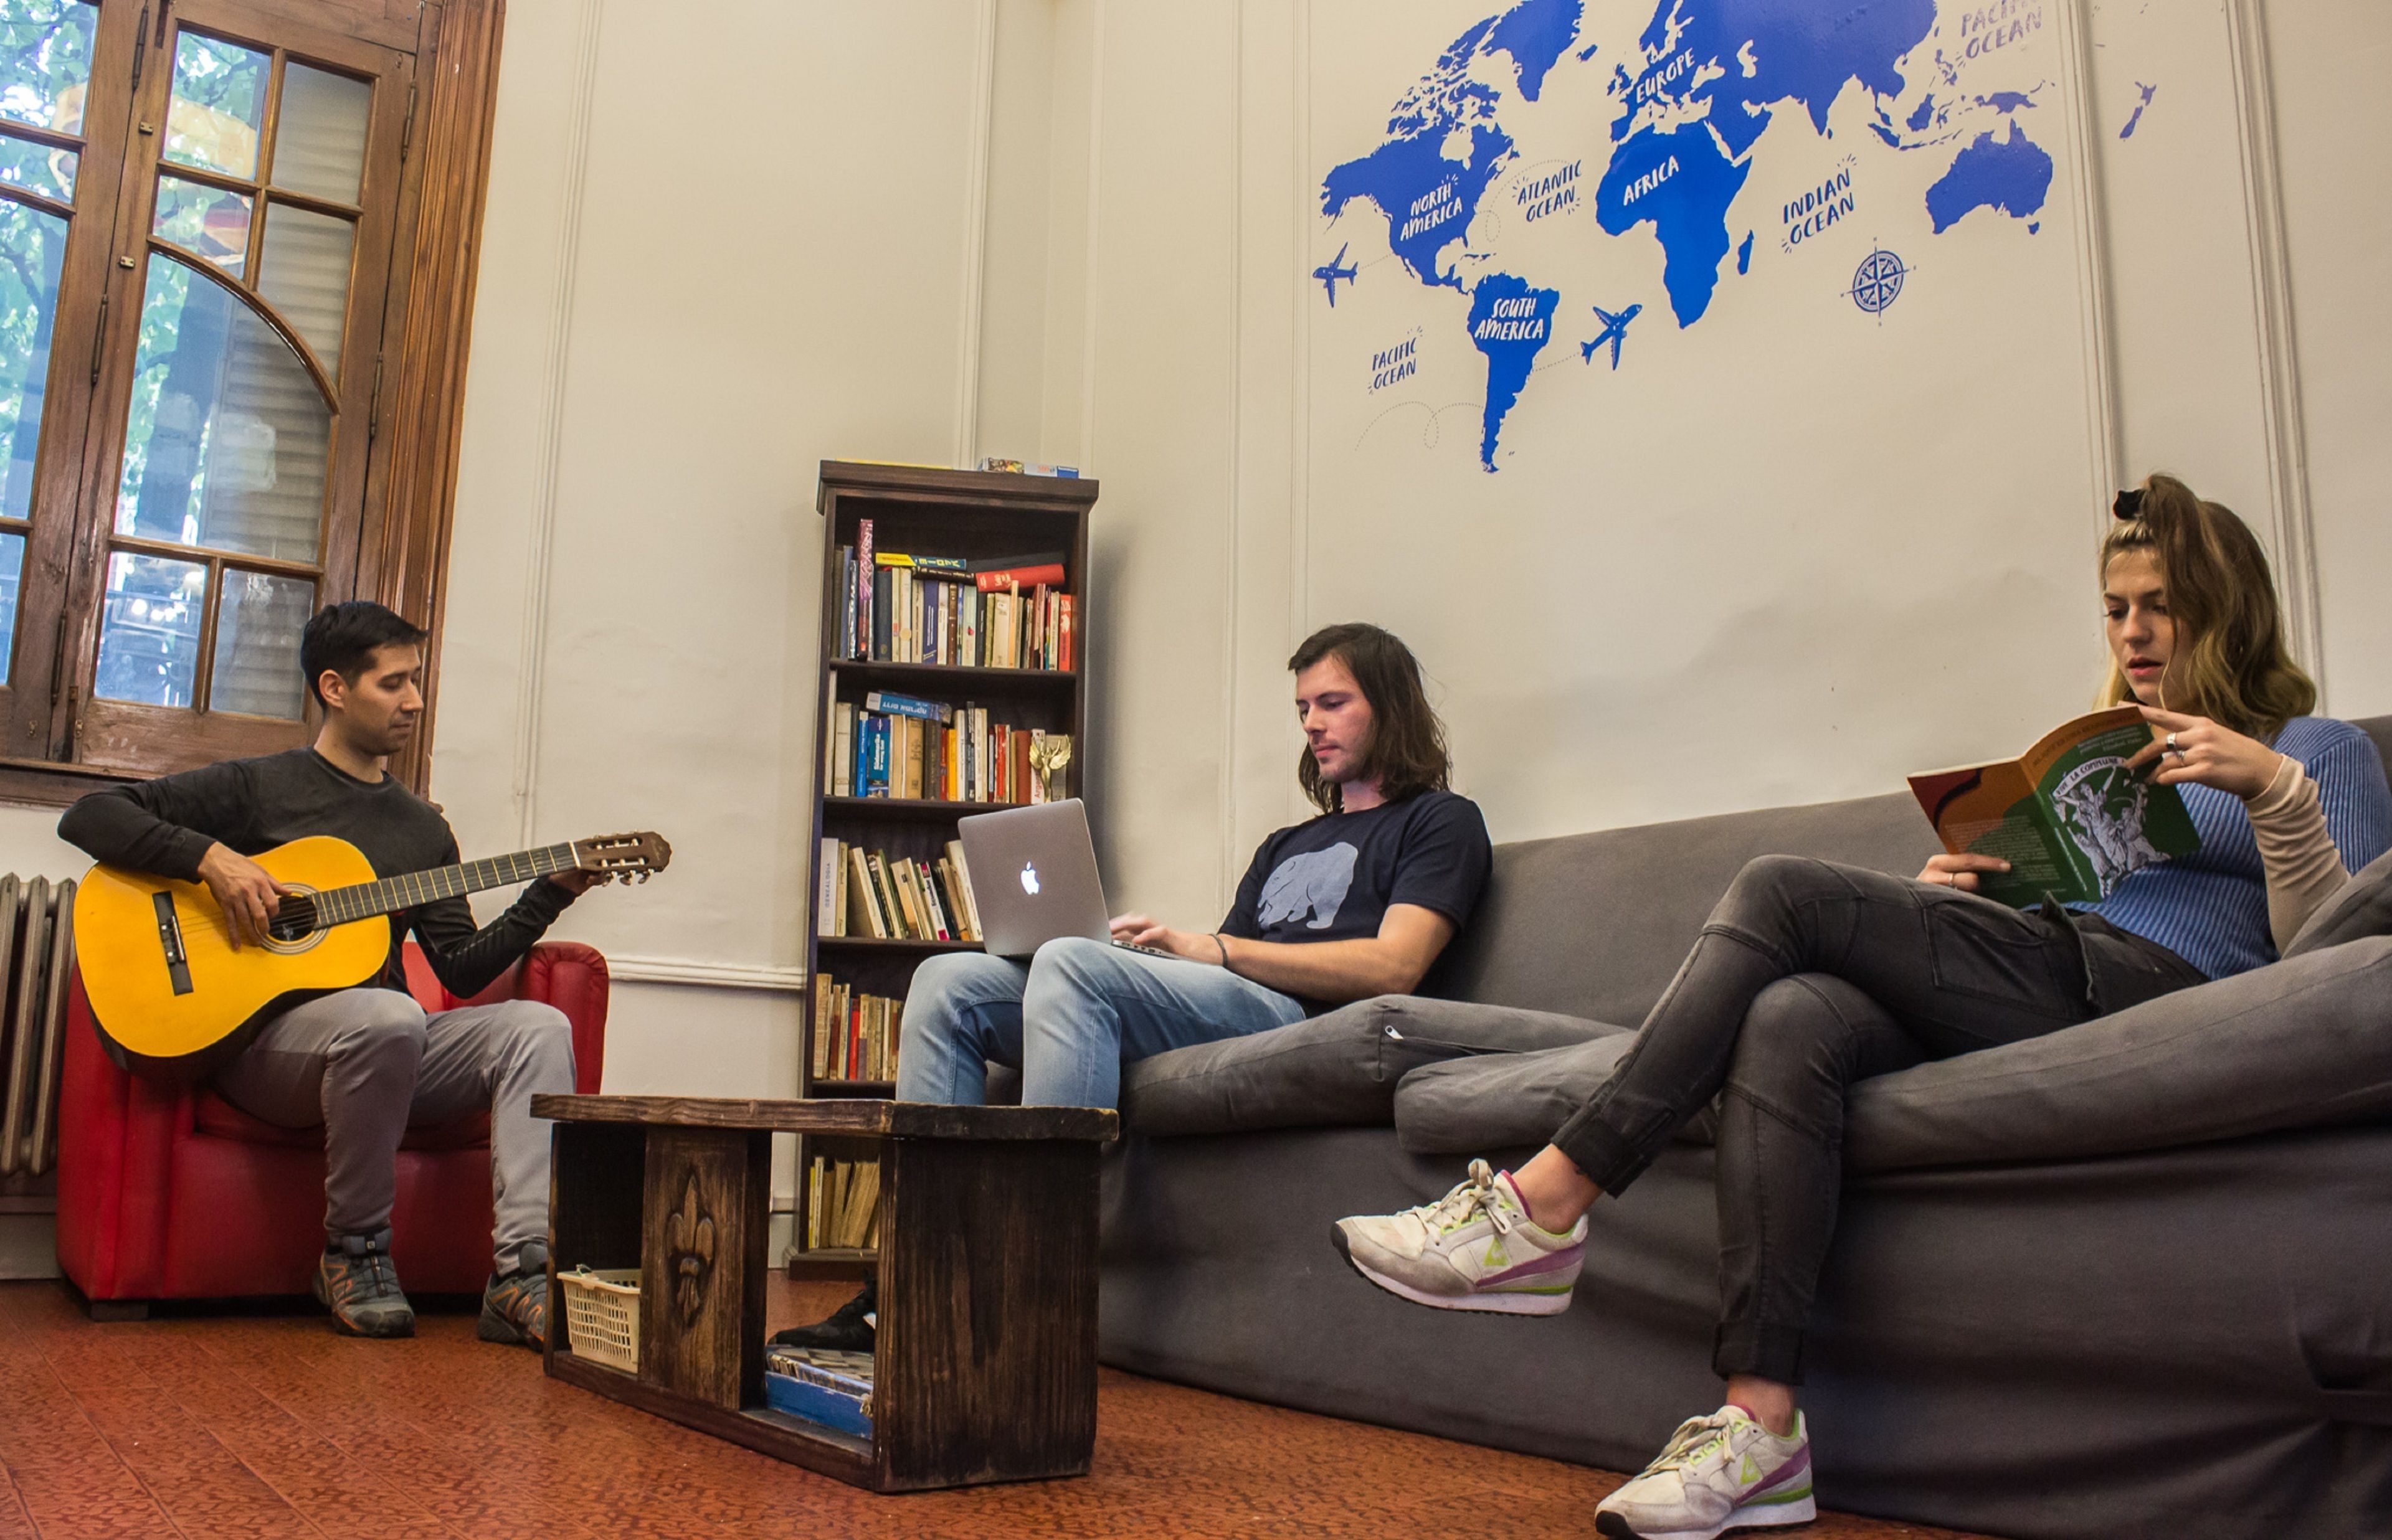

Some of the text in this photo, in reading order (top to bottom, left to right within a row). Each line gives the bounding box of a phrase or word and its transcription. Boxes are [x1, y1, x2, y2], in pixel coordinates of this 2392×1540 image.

[1961, 0, 2036, 37] PACI
[1966, 6, 2041, 59] OCEAN
[1636, 48, 1695, 104] EUROPE
[1517, 159, 1583, 206] ATLANTIC
[1623, 155, 1680, 206] AFRICA
[1783, 168, 1851, 224] INDIAN
[1400, 196, 1463, 241] AMERICA
[1411, 183, 1452, 217] NORTH
[1526, 186, 1577, 222] OCEAN
[1790, 192, 1855, 245] OCEAN
[1493, 298, 1537, 318] SOUTH
[1474, 318, 1544, 341] AMERICA
[1372, 338, 1417, 371] PACIFIC
[1374, 359, 1417, 390] OCEAN
[2070, 771, 2080, 782] LA
[2080, 757, 2119, 773] COMMUNE
